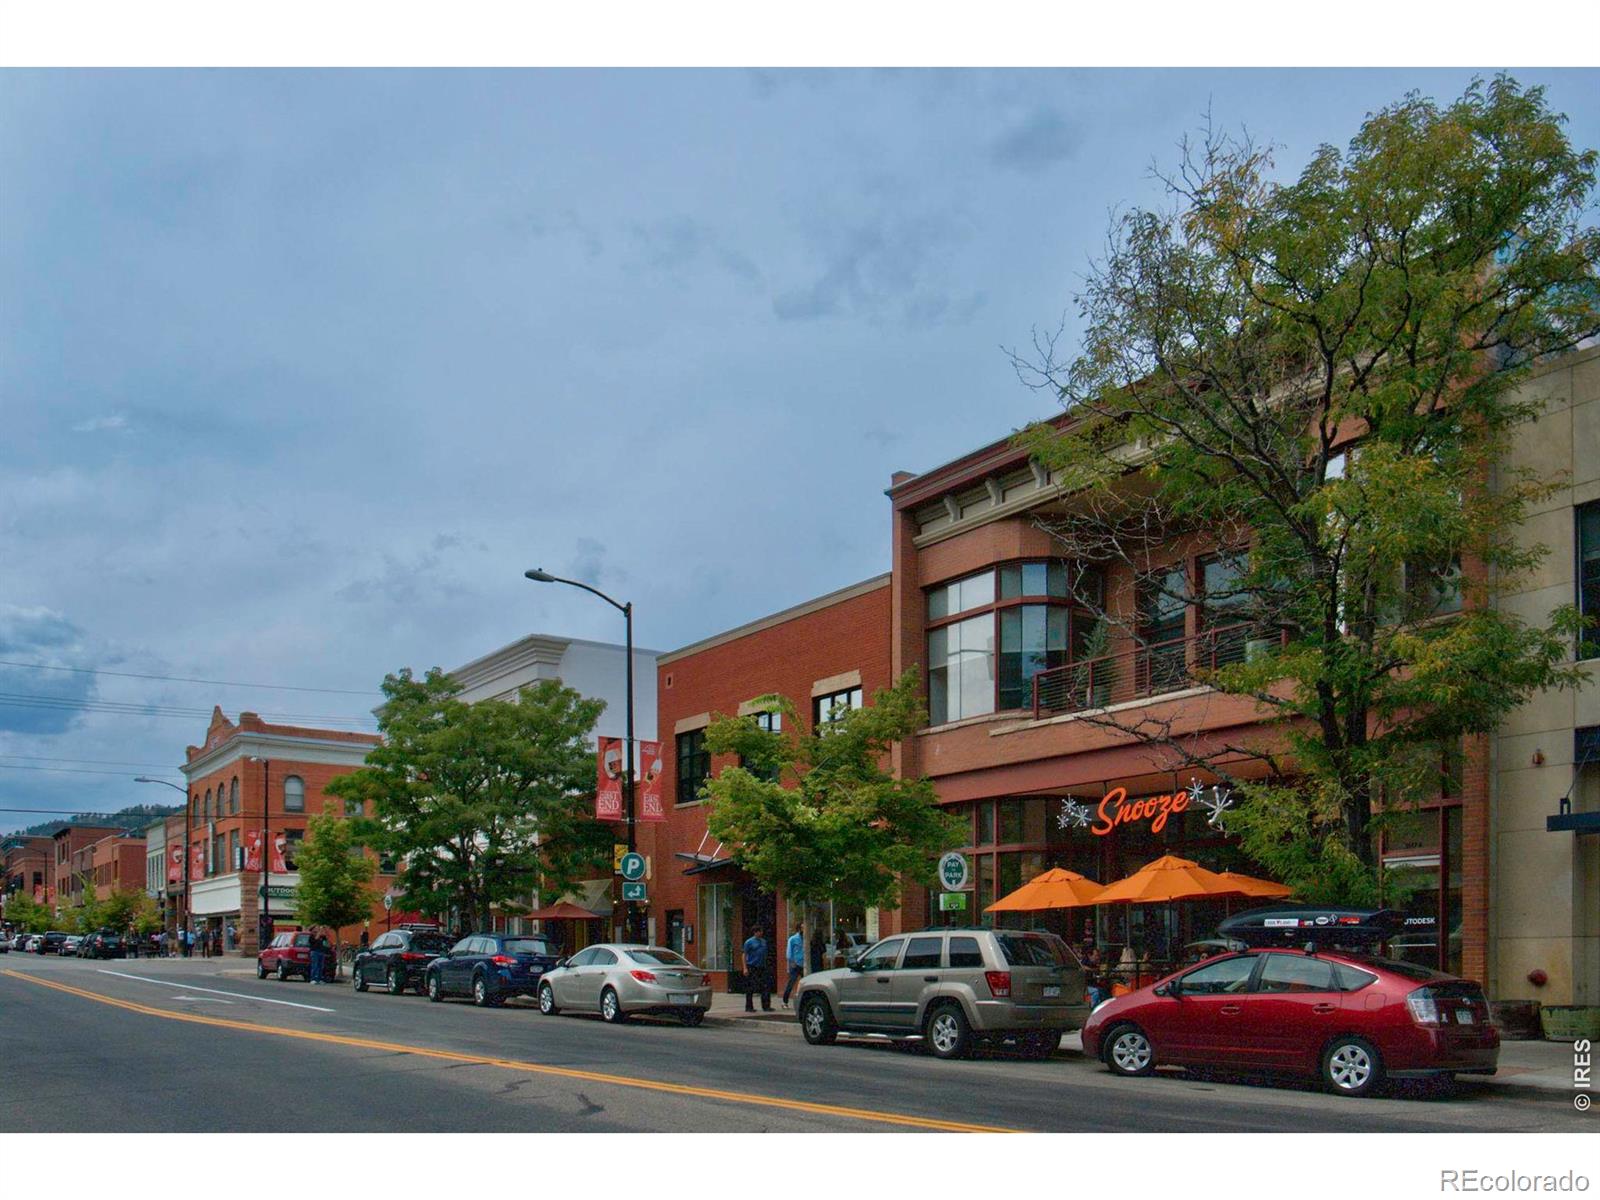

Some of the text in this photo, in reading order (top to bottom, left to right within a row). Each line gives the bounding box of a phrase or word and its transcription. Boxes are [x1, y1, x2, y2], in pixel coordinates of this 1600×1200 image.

[598, 800, 620, 810] END
[1091, 787, 1188, 836] Snooze
[627, 859, 640, 875] P
